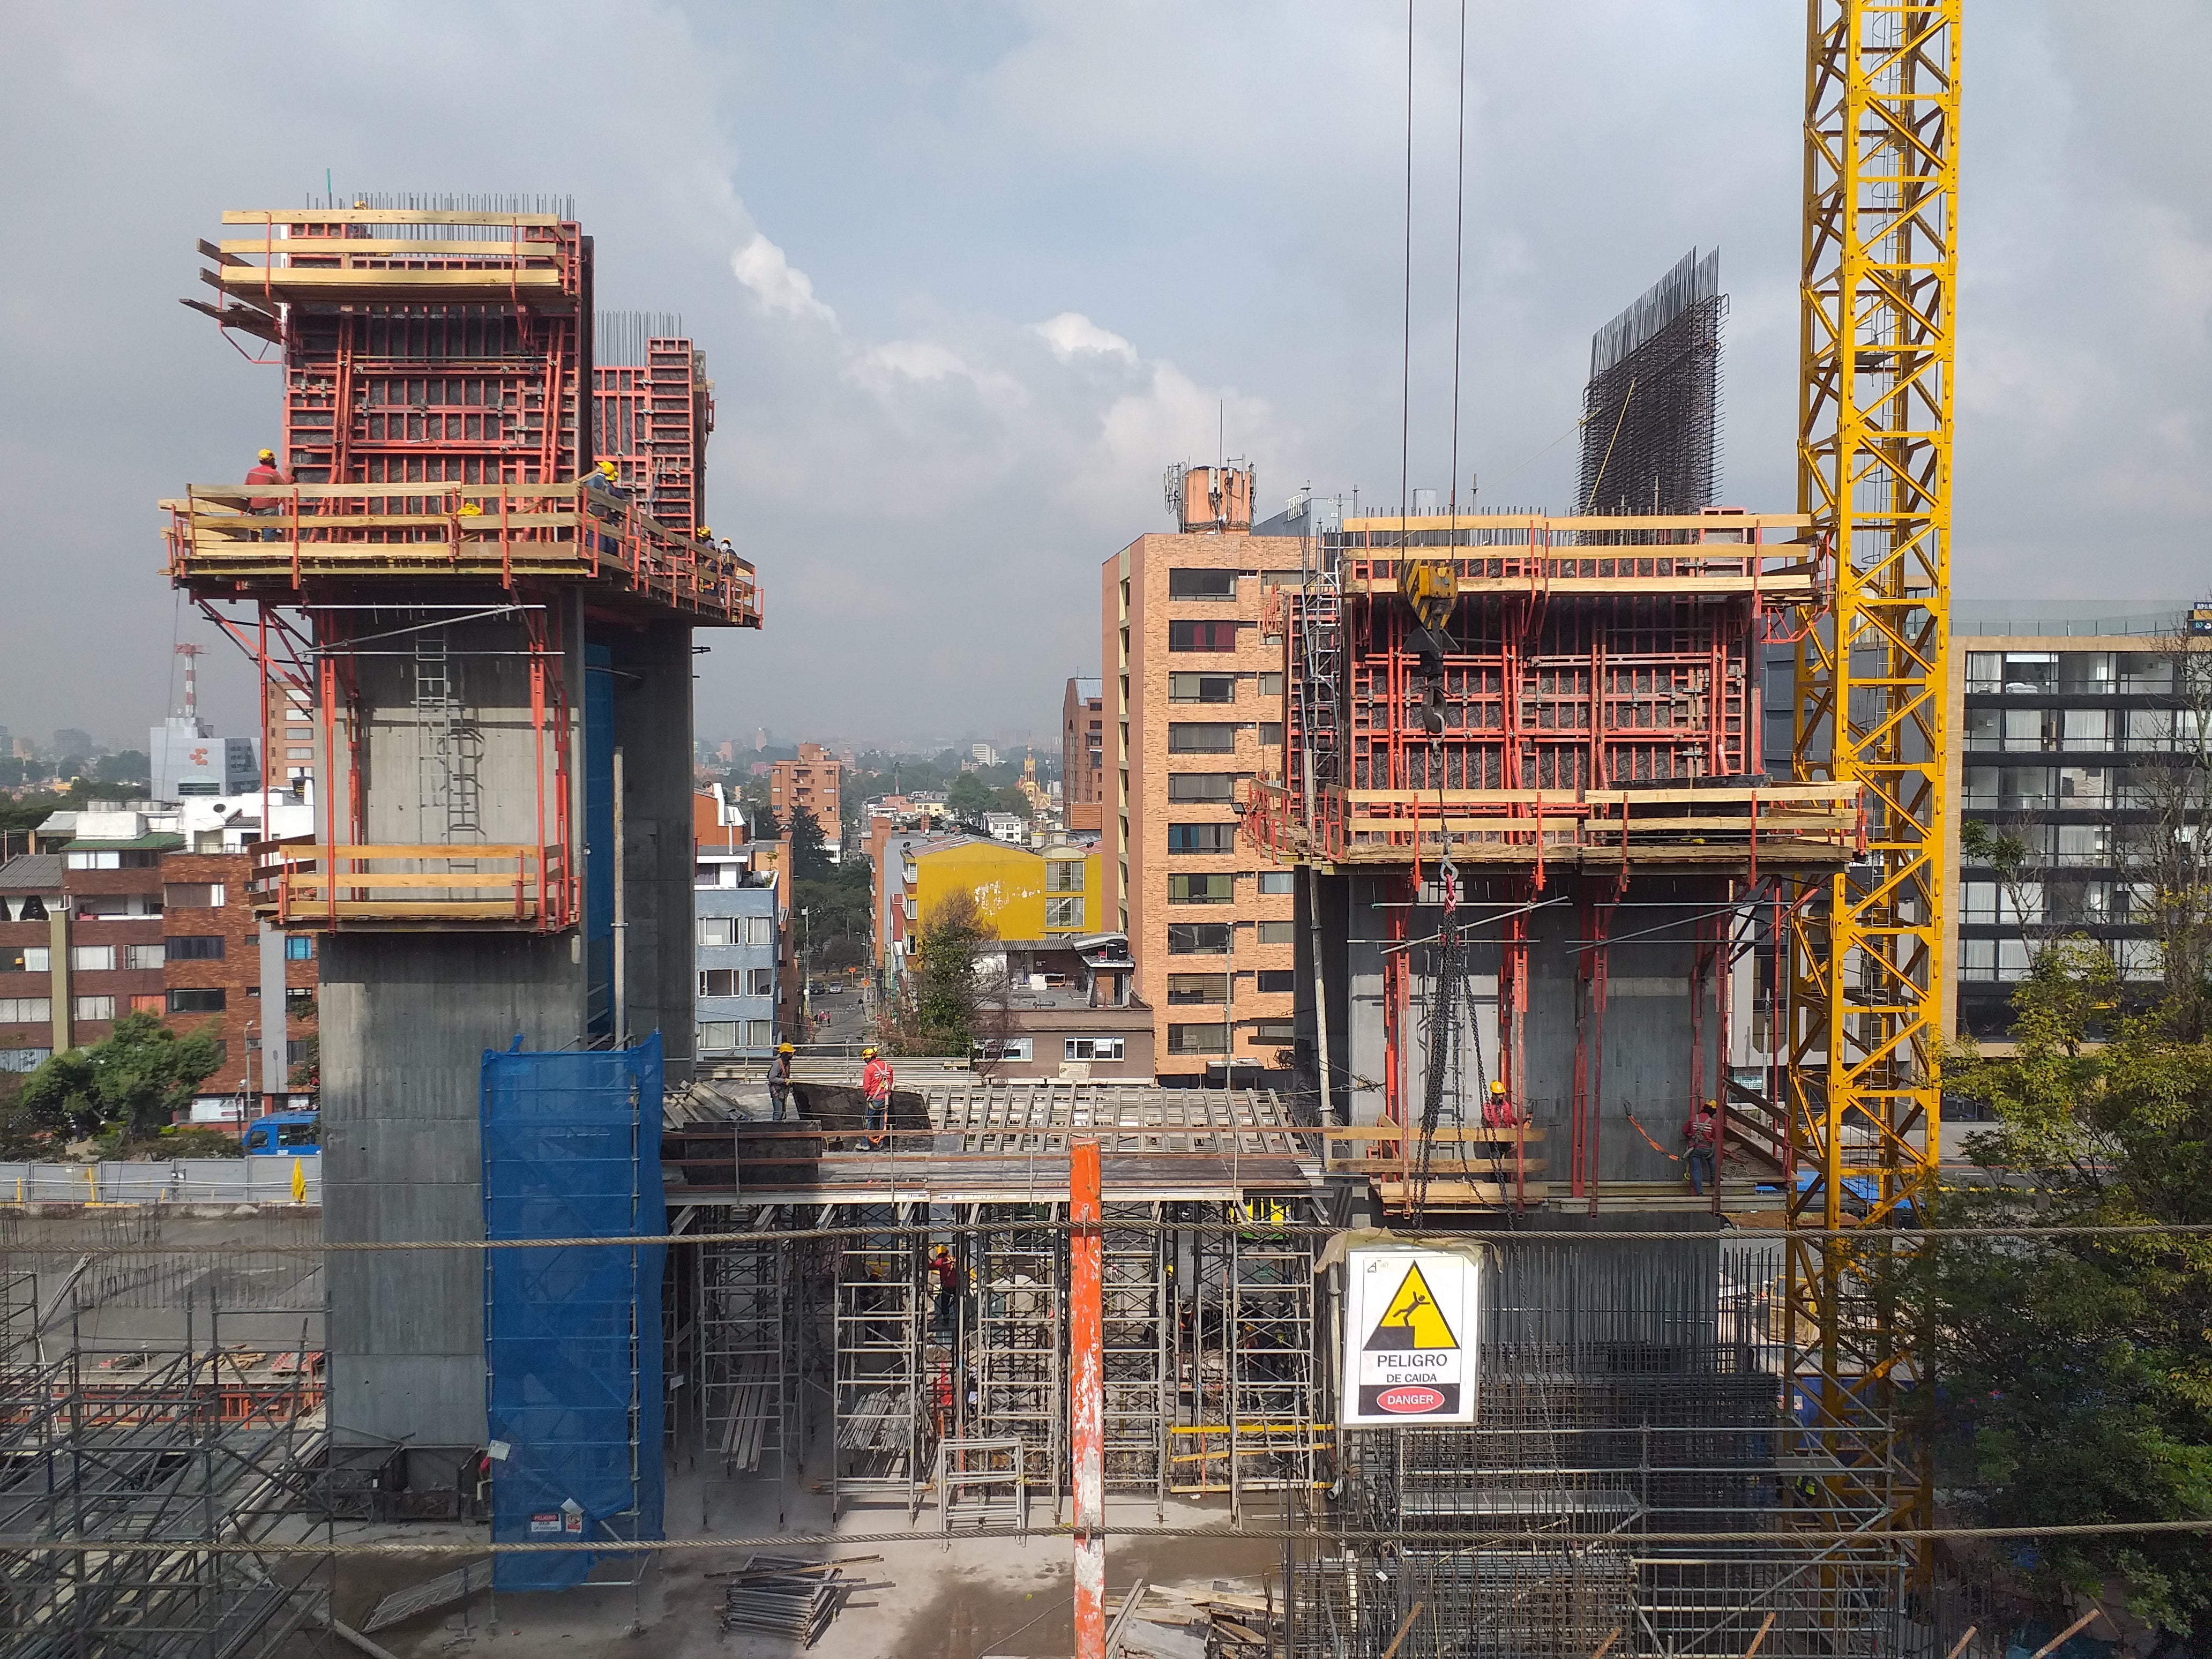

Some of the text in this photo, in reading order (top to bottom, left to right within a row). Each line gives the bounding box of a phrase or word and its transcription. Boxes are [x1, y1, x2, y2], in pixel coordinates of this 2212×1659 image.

[1378, 1354, 1447, 1367] PELIGRO
[1386, 1373, 1437, 1383] DE CAIDA
[1387, 1395, 1434, 1405] DANGER
